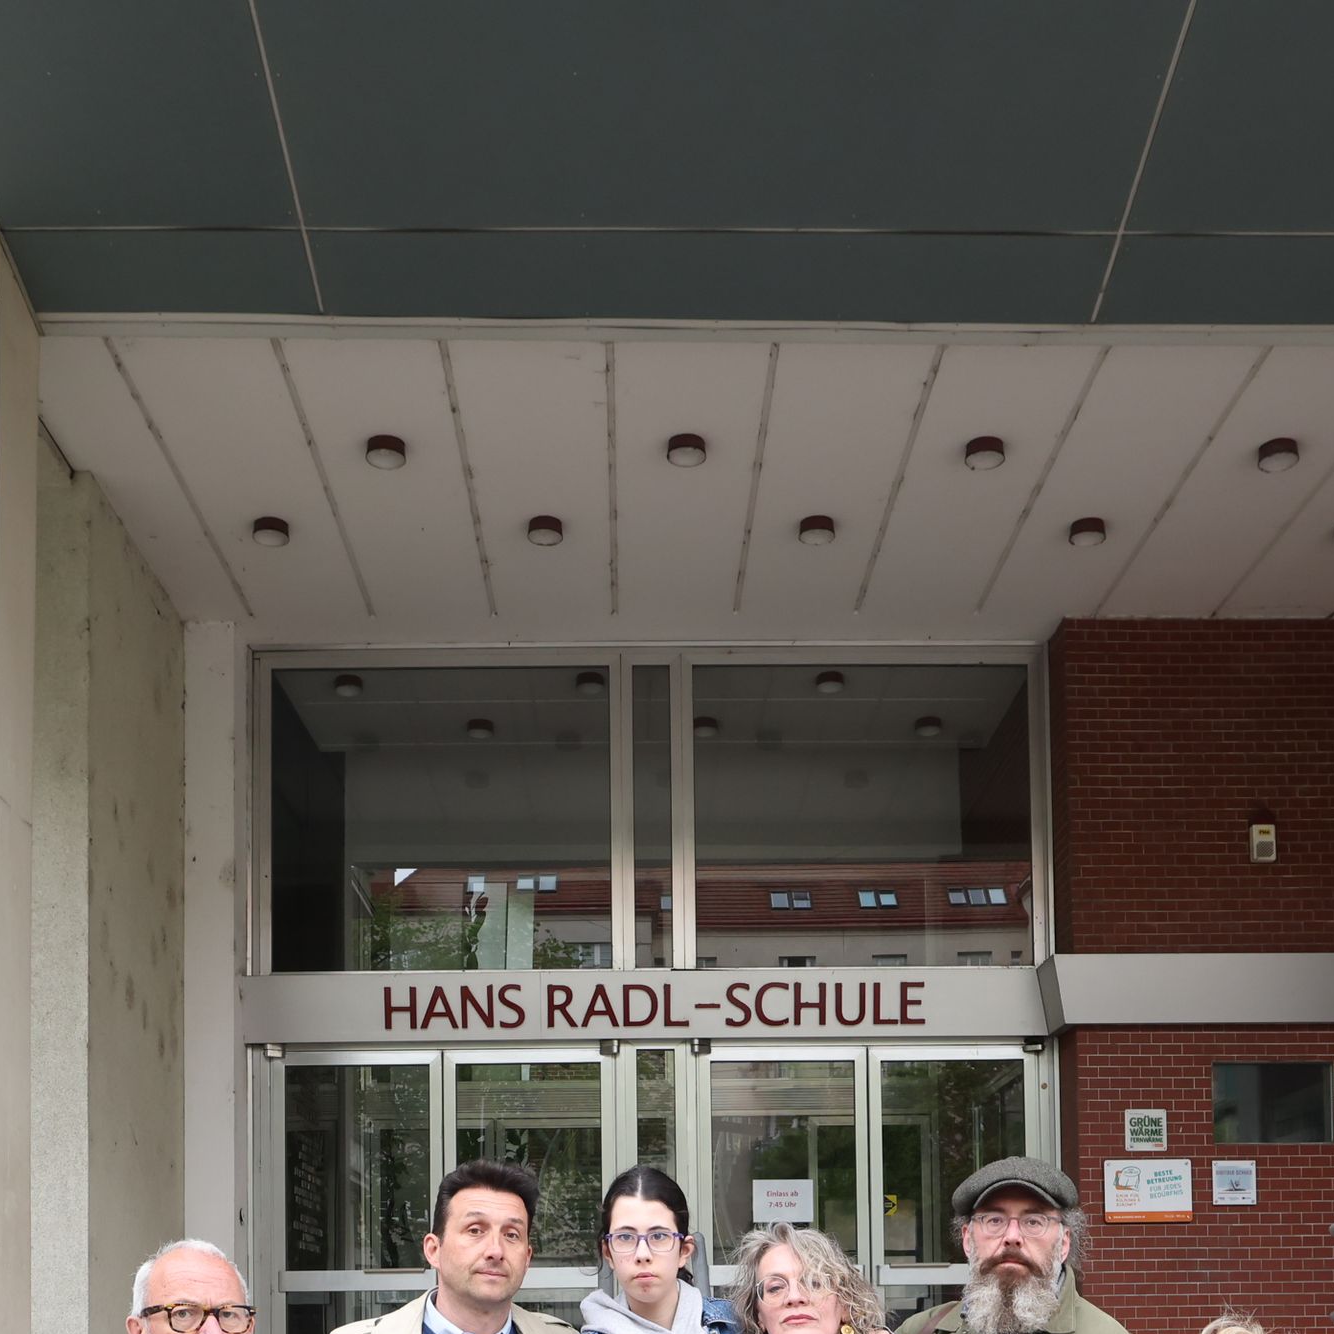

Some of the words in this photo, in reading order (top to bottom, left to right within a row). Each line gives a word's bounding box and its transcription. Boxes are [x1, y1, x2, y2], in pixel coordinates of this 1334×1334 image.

[382, 983, 527, 1031] HANS
[1129, 1115, 1163, 1127] GRÜNE
[1129, 1127, 1163, 1136] WÄRME
[1147, 1176, 1182, 1185] BETREUUNG
[1164, 1183, 1182, 1191] JEDES
[1150, 1190, 1184, 1199] BEDÜRFNIS
